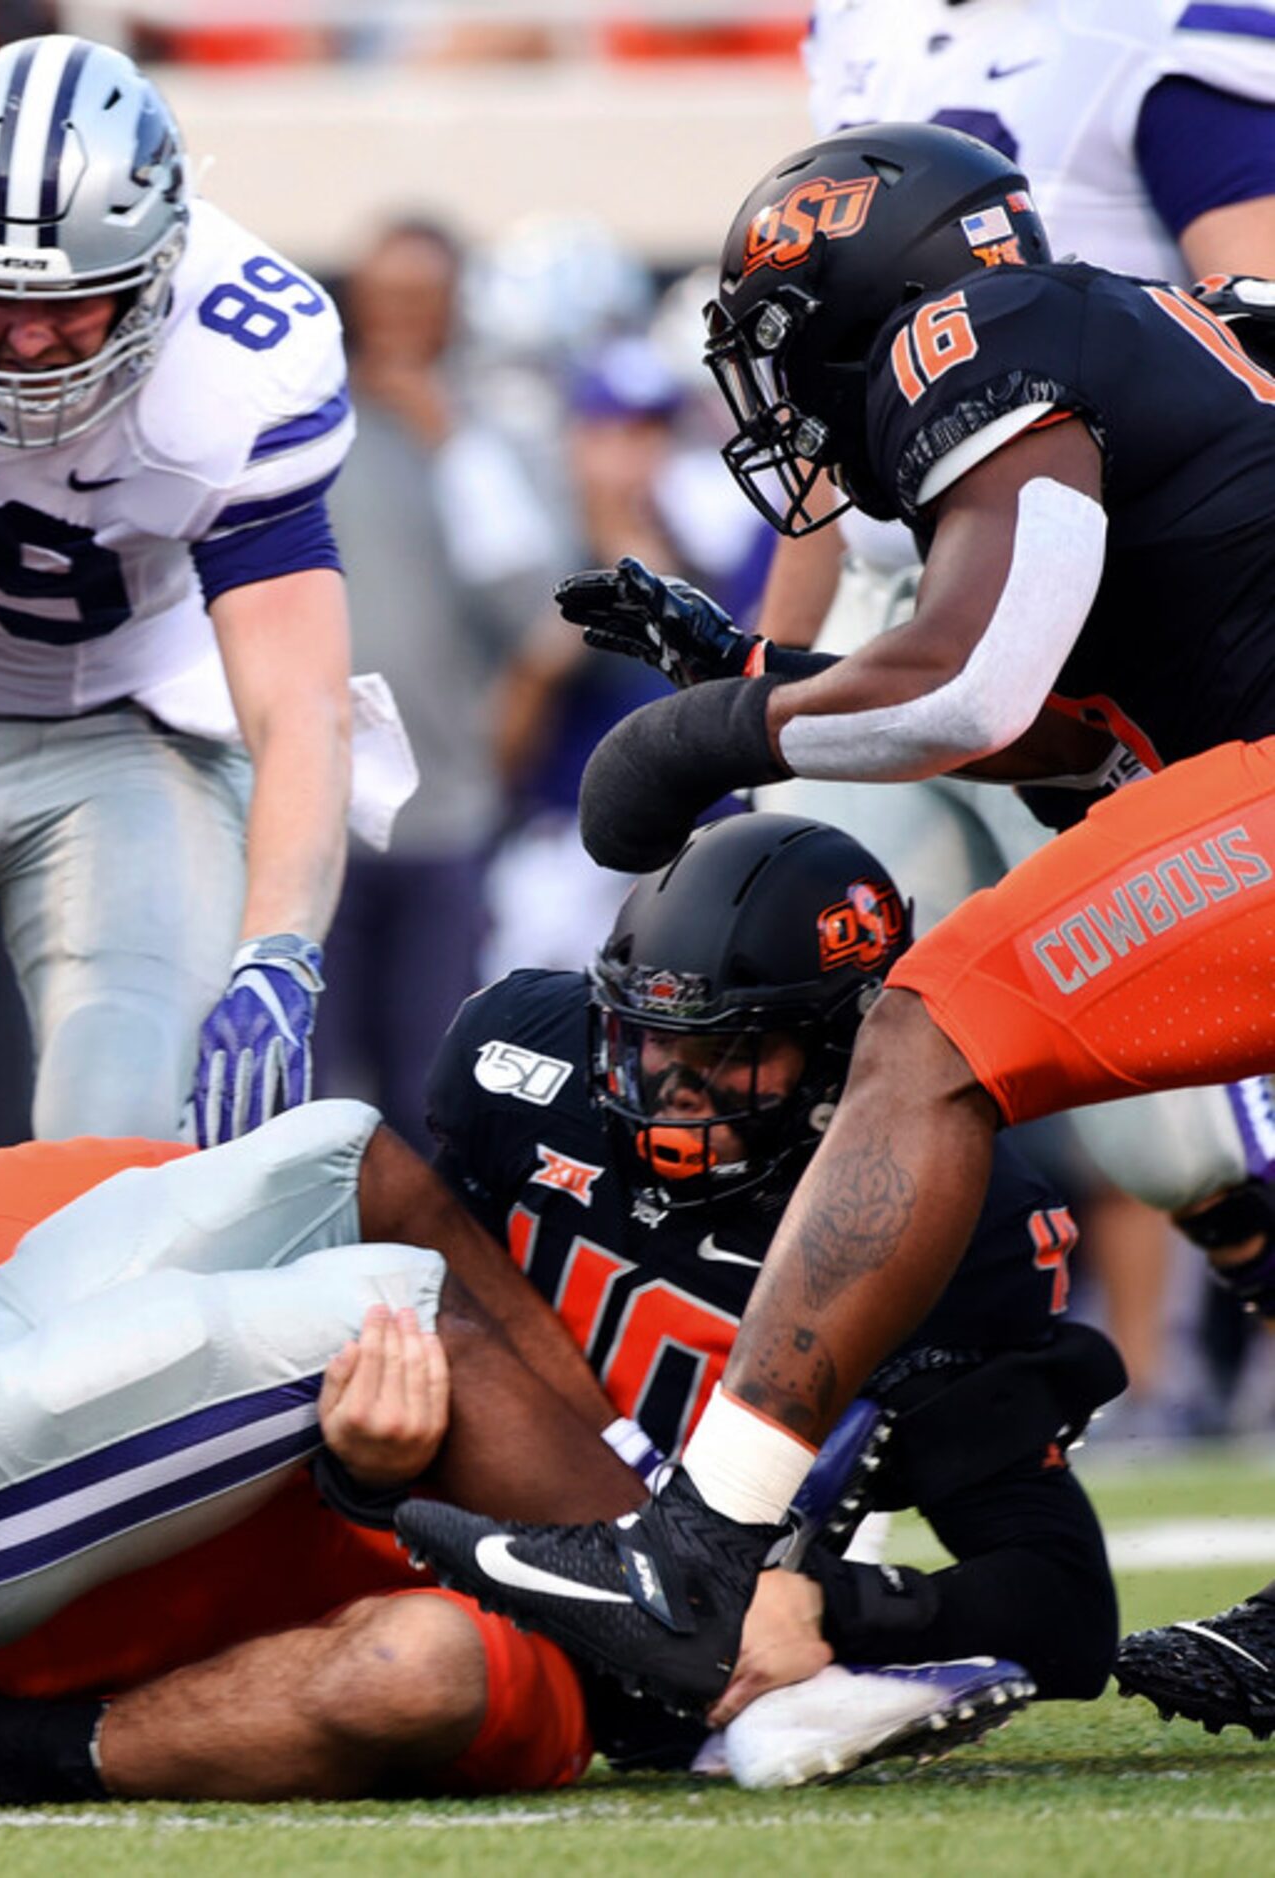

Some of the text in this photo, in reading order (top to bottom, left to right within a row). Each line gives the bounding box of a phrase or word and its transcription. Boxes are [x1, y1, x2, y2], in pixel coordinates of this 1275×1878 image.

[742, 175, 880, 277] OSU
[198, 256, 326, 352] 89
[891, 290, 979, 407] 16
[1032, 824, 1272, 995] COWBOYS
[473, 1040, 575, 1107] 150
